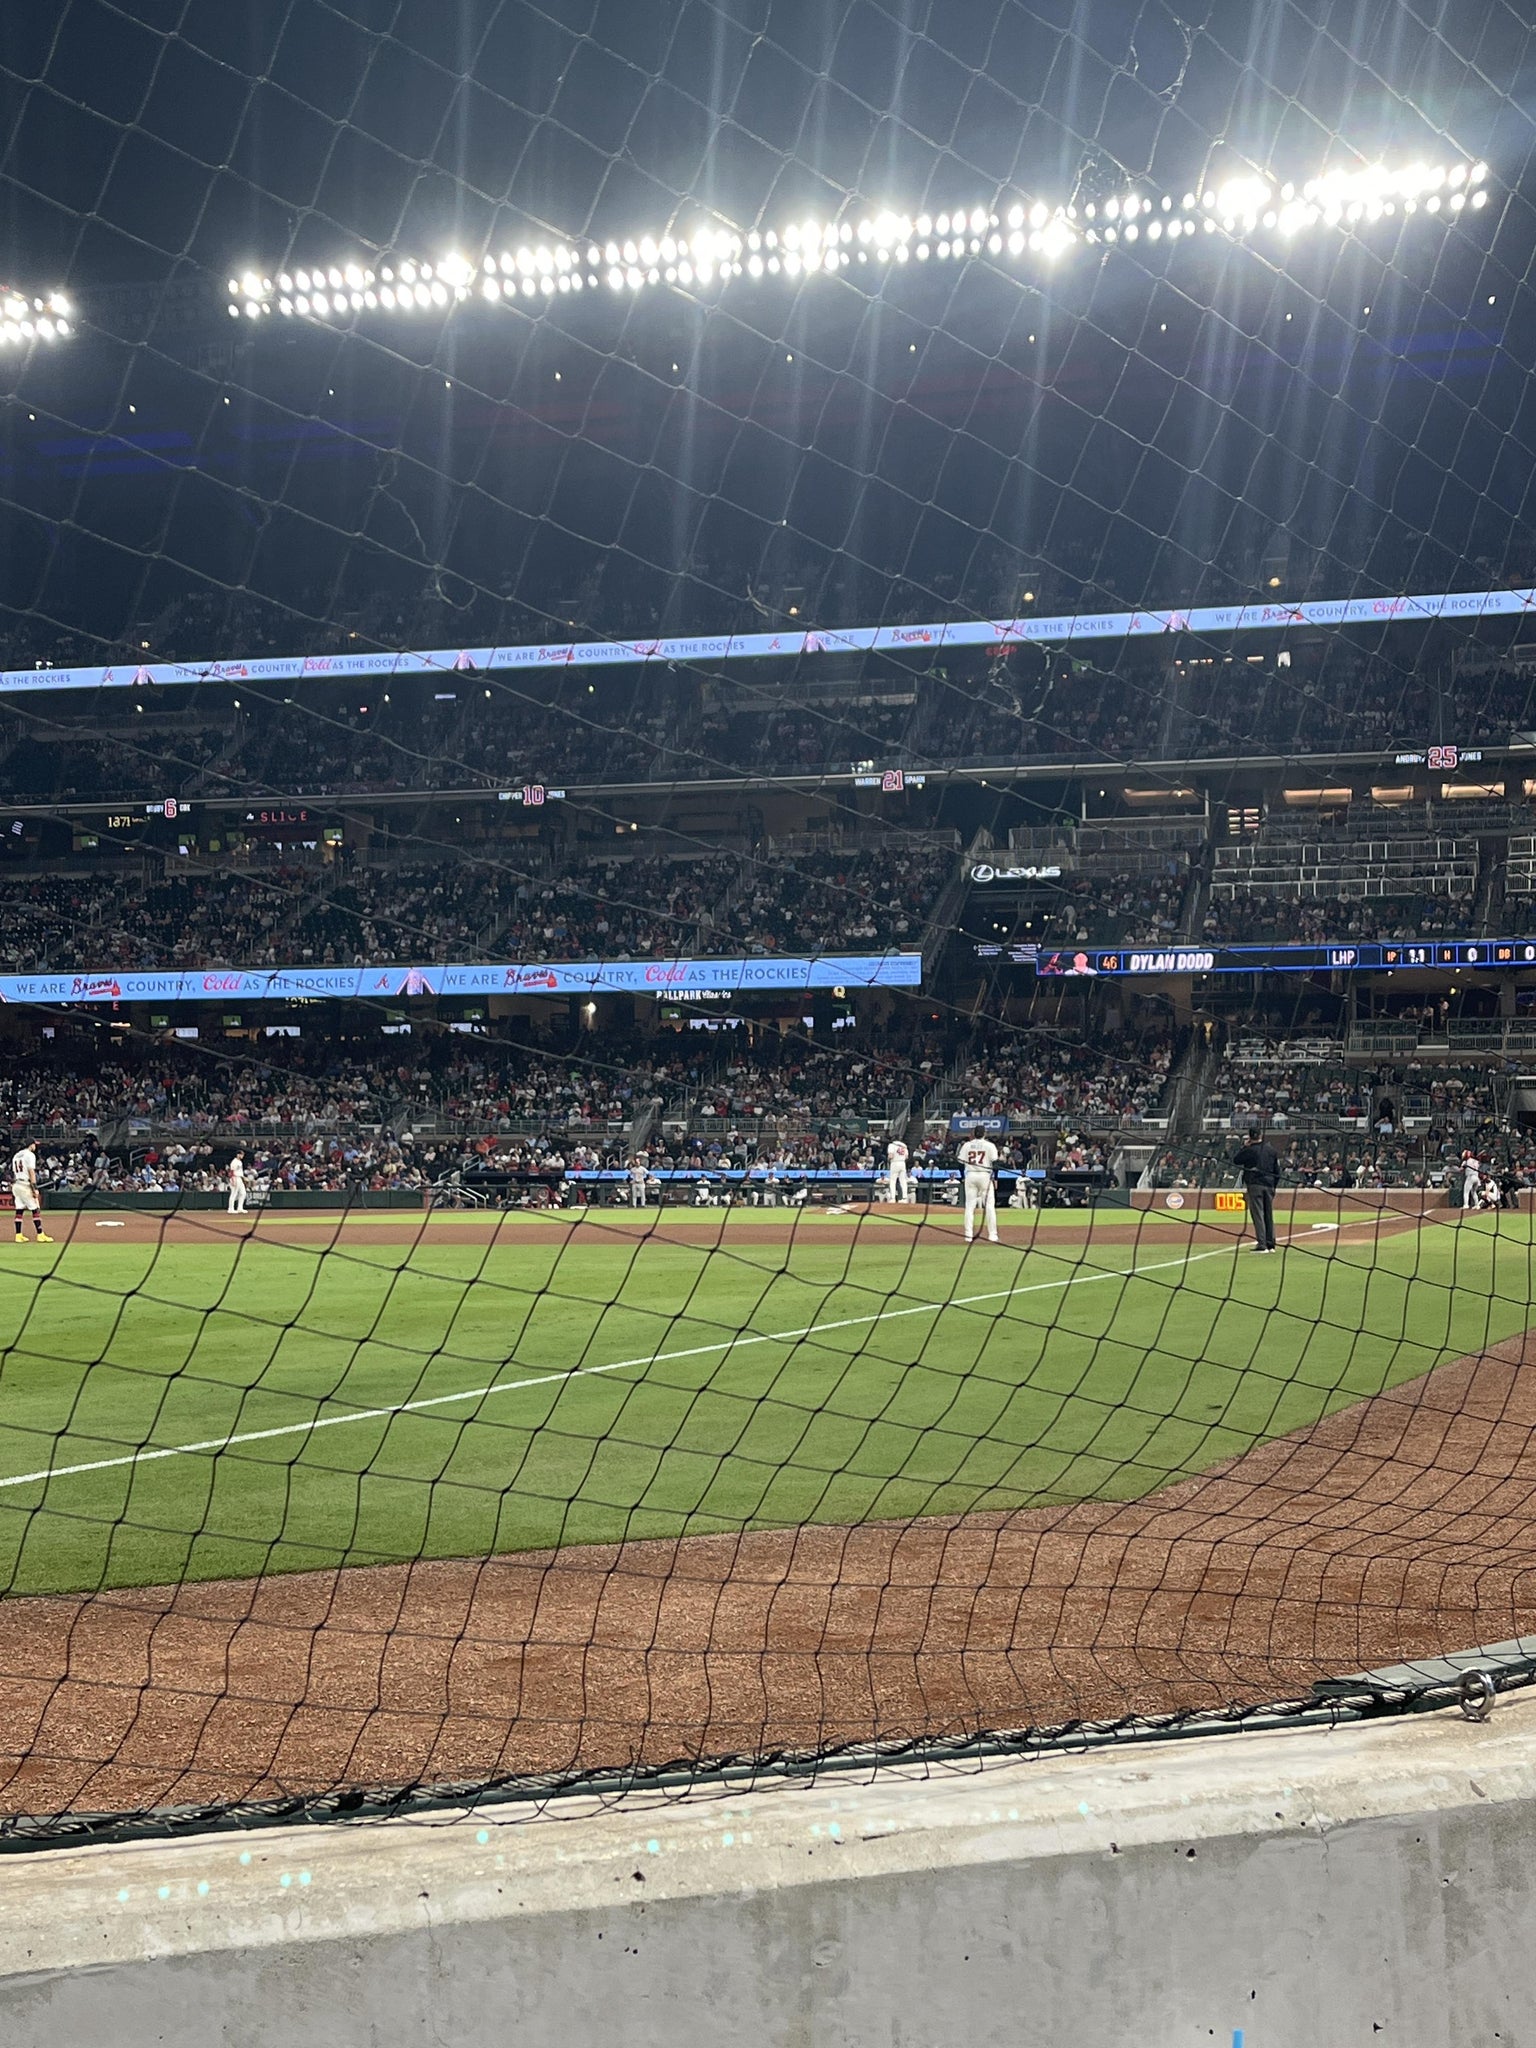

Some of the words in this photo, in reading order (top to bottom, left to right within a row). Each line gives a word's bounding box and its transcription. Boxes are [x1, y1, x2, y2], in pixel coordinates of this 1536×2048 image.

[1451, 598, 1502, 610] ROCKIES
[1043, 622, 1064, 633] THE
[497, 652, 513, 662] WE
[514, 651, 535, 662] ARE
[680, 643, 698, 653] THE
[347, 659, 366, 671] THE
[12, 675, 30, 686] THE
[31, 673, 72, 685] ROCKIES
[1427, 745, 1458, 769] 25
[882, 769, 904, 791] 21
[522, 784, 545, 806] 10
[164, 798, 177, 818] 6
[995, 865, 1061, 879] LEXUS
[1332, 949, 1356, 966] LHP
[1386, 950, 1397, 963] IP
[1443, 949, 1452, 961] H
[1524, 945, 1536, 961] 0
[1102, 955, 1118, 970] 46
[1129, 953, 1176, 971] DYLAN
[1176, 952, 1215, 970] DODD
[446, 973, 466, 986] WE
[470, 973, 499, 986] ARE
[503, 967, 549, 988] Braves
[563, 970, 639, 985] COUNTRY,
[645, 962, 689, 982] Cold
[688, 969, 706, 982] AS
[711, 968, 739, 981] THE
[744, 967, 808, 980] ROCKIES
[16, 982, 36, 995] WE
[39, 982, 67, 995] ARE
[70, 977, 113, 996] Braves
[126, 980, 197, 993] COUNTRY,
[202, 973, 244, 992] Cold
[243, 979, 260, 991] AS
[295, 976, 355, 989] ROCKIES
[958, 1119, 1002, 1129] GEICO
[967, 1150, 987, 1165] 27
[14, 1159, 25, 1173] 14
[1215, 1192, 1246, 1210] 005
